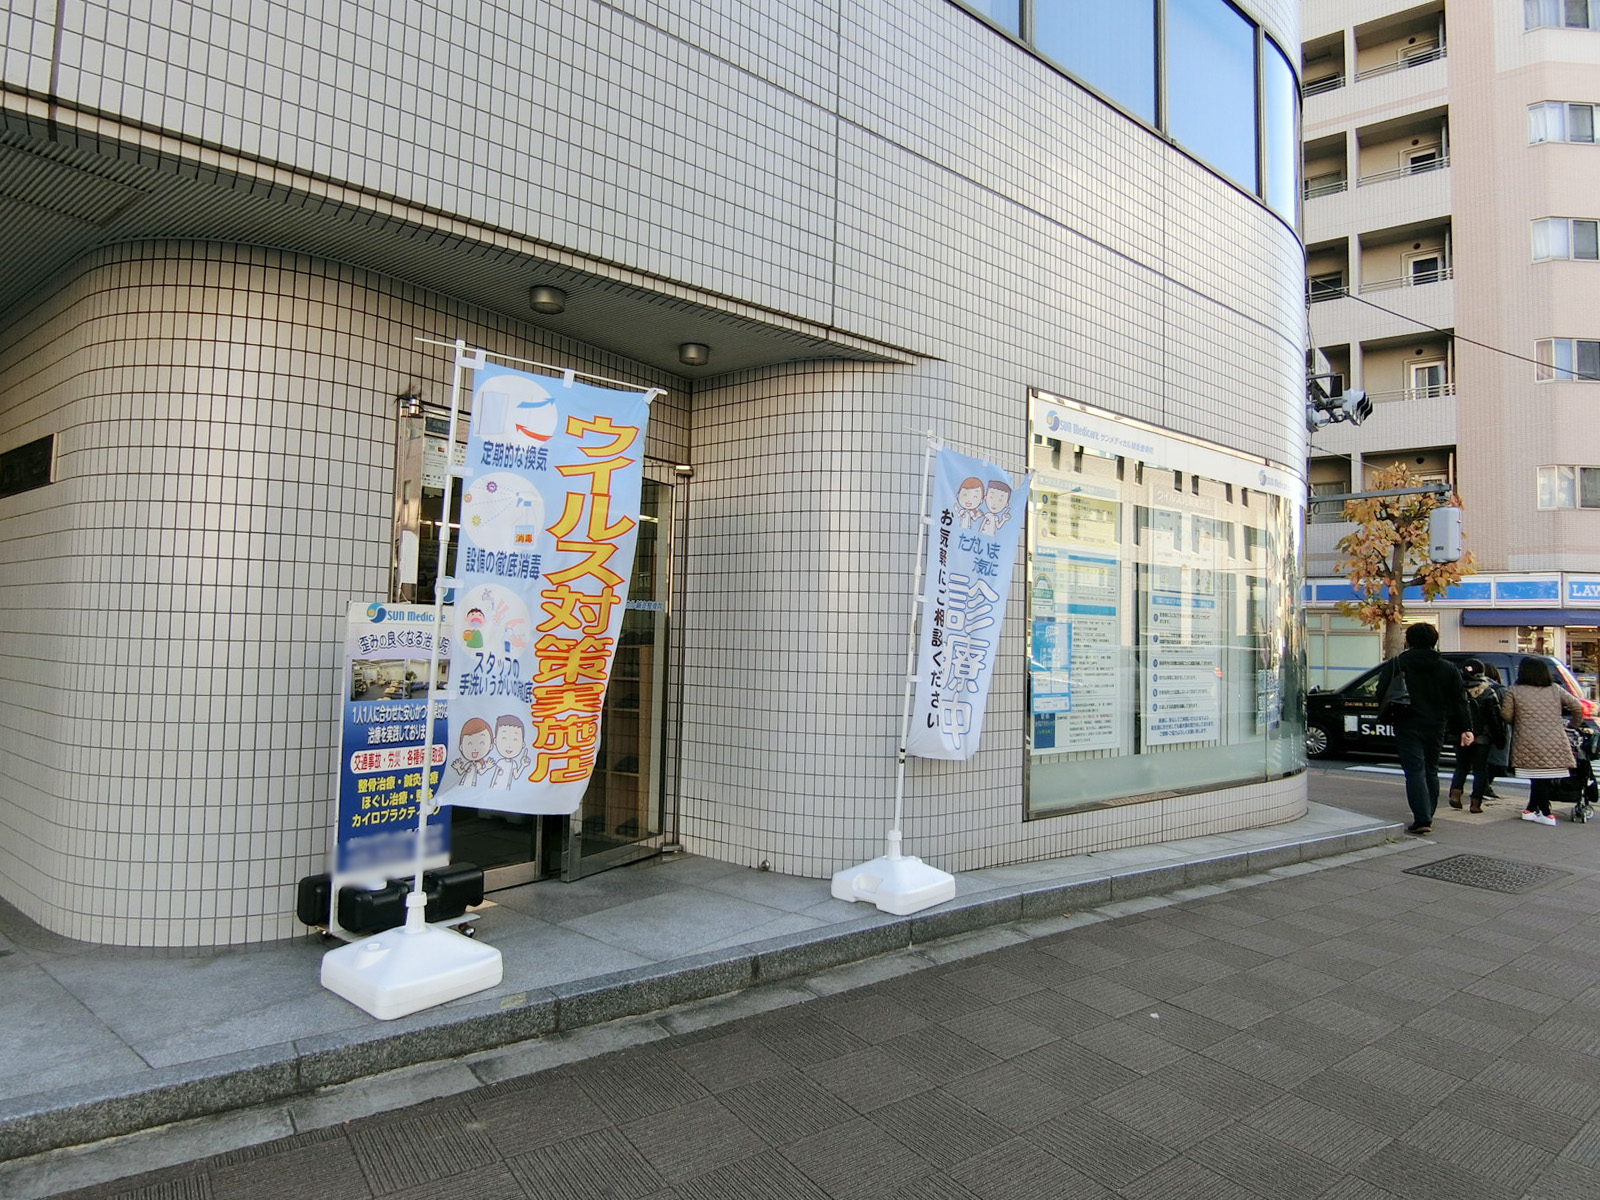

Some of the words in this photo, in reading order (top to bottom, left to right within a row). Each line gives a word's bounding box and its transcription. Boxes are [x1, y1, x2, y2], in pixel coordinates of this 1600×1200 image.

[480, 440, 549, 472] 定期的な換気
[515, 533, 533, 544] 消毒
[465, 546, 542, 581] 設備の徹底消毒
[529, 414, 640, 784] ウイルス対策実施店
[407, 610, 446, 623] Medice
[926, 508, 954, 729] お気軽にご相談ください
[358, 629, 451, 655] 歪みの良くなる治院
[474, 651, 520, 680] スタッフの
[941, 572, 999, 750] 診療中
[352, 702, 448, 725] 1人1人に合わせた安心かつ果的な
[367, 724, 427, 746] 治療を実践しておりま
[354, 746, 444, 771] 交通事故・労災・各種保取扱
[357, 770, 439, 793] 整骨治療・鍼灸療
